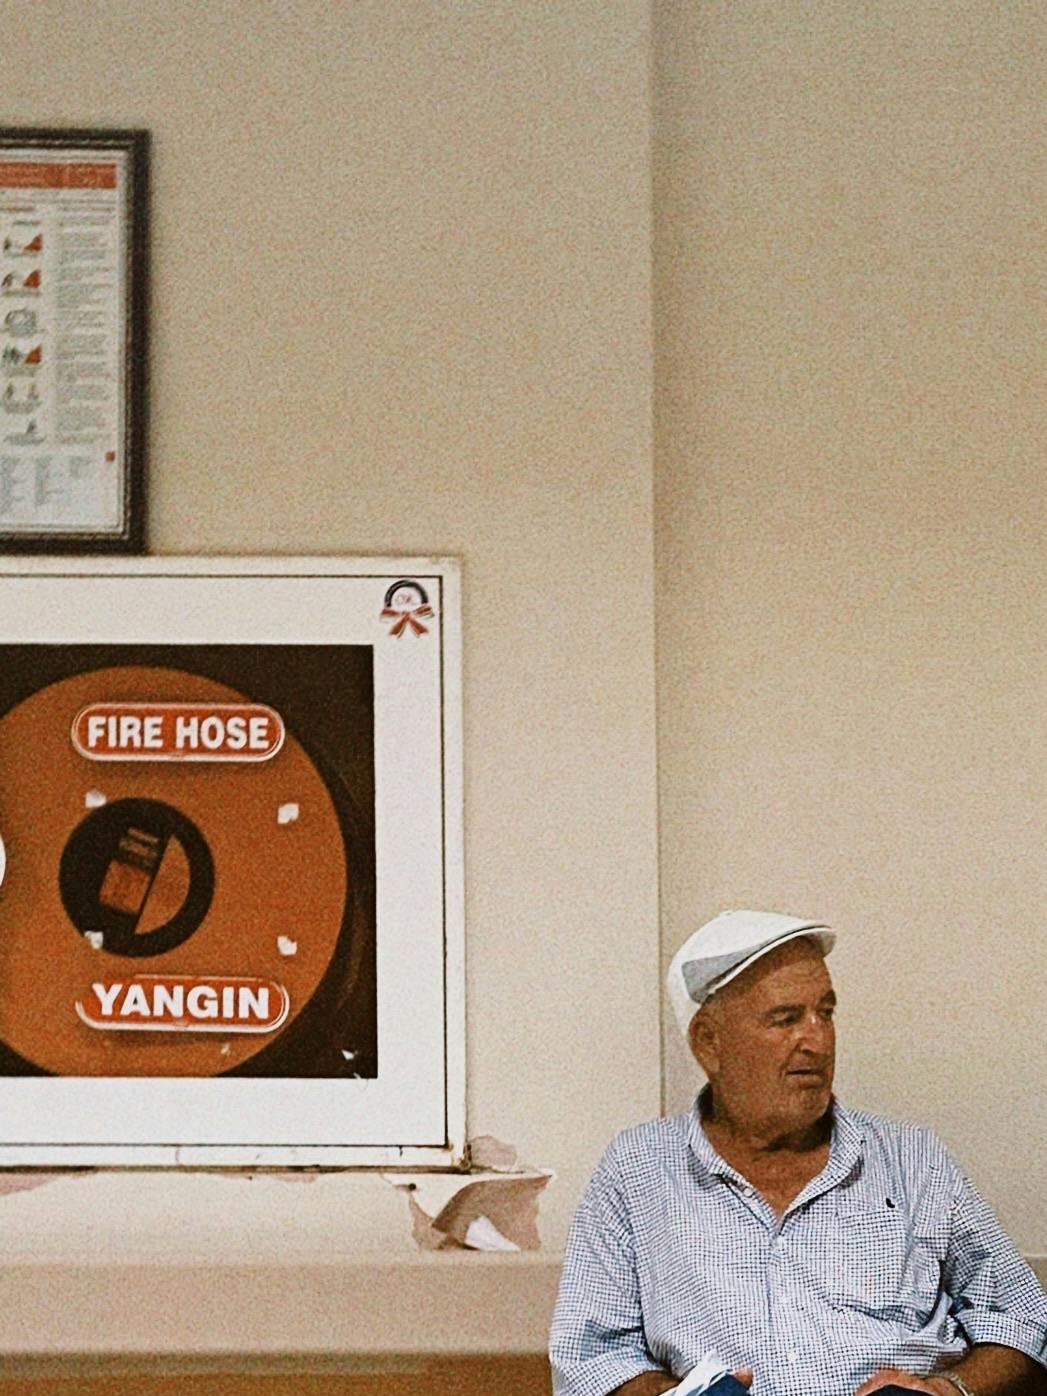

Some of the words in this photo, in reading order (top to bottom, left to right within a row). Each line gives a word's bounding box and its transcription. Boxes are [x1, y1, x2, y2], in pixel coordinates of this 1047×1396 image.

[88, 716, 164, 748] FIRE
[175, 716, 270, 749] HOSE
[92, 983, 270, 1019] YANGIN
